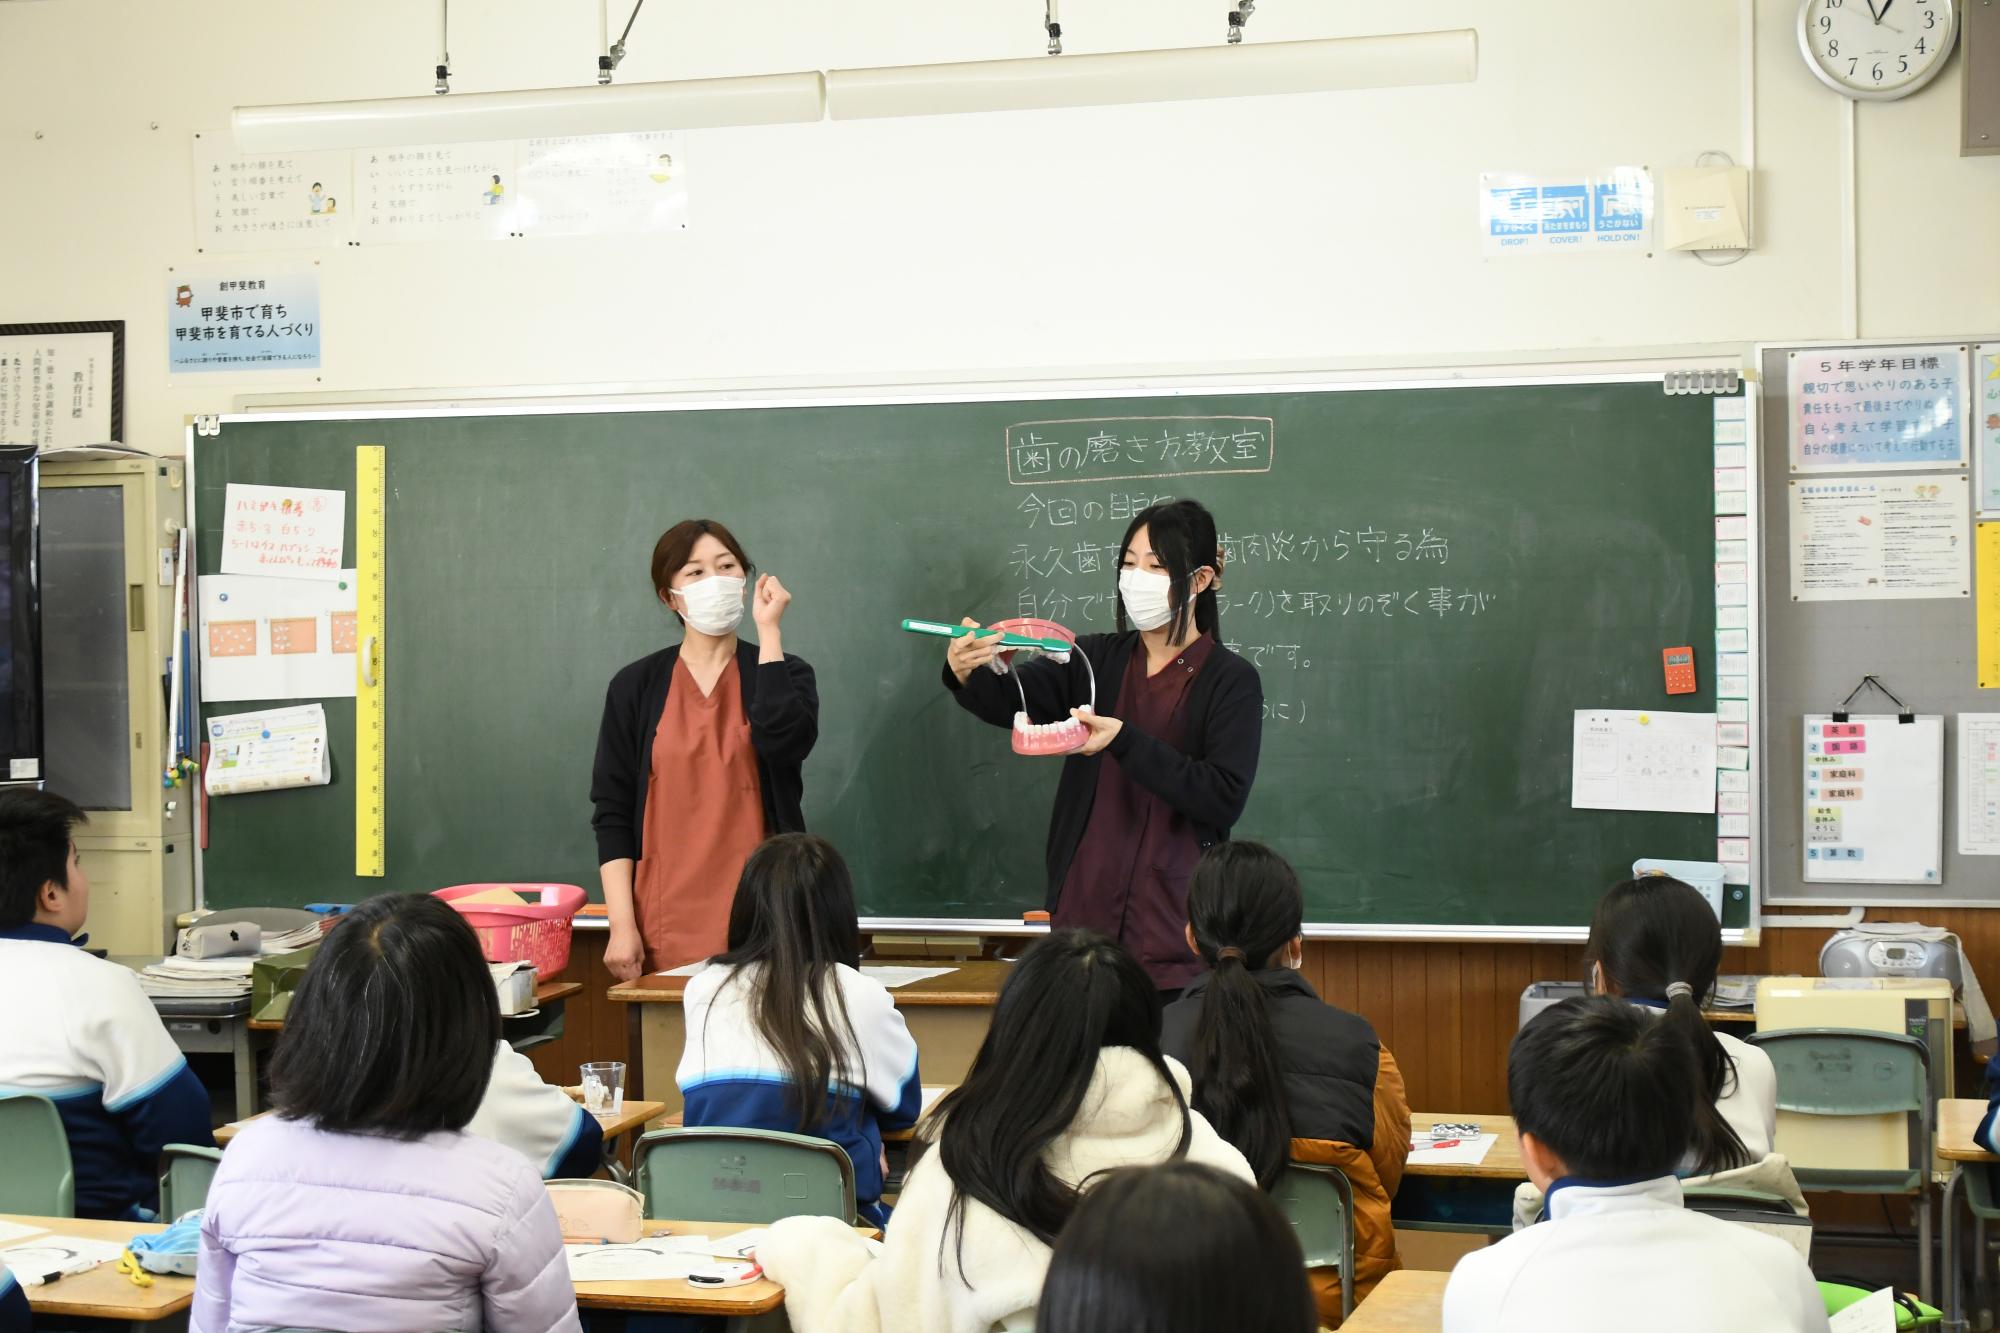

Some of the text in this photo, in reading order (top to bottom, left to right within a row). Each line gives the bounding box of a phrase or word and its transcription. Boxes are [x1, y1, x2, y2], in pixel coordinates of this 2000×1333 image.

[1820, 16, 1831, 34] 9
[1923, 10, 1935, 29] 3
[1828, 40, 1839, 57] 8
[1914, 36, 1926, 54] 4
[1848, 57, 1858, 76] 7
[1872, 62, 1883, 80] 6
[1897, 54, 1908, 72] 5
[1550, 235, 1582, 243] COVER!
[1597, 233, 1639, 242] HOLD ON!
[220, 280, 265, 291] 創甲斐教育
[201, 304, 287, 321] 甲斐市で育ち
[176, 323, 313, 341] 甲斐市を育てる人づくり
[1802, 377, 1954, 395] 親切で思いやりのある子
[1803, 399, 1953, 415] 責任をもって最後までやりぬ
[1804, 421, 1954, 435] 自ら考えて学習す子
[1011, 430, 1265, 475] 歯の磨き方教室
